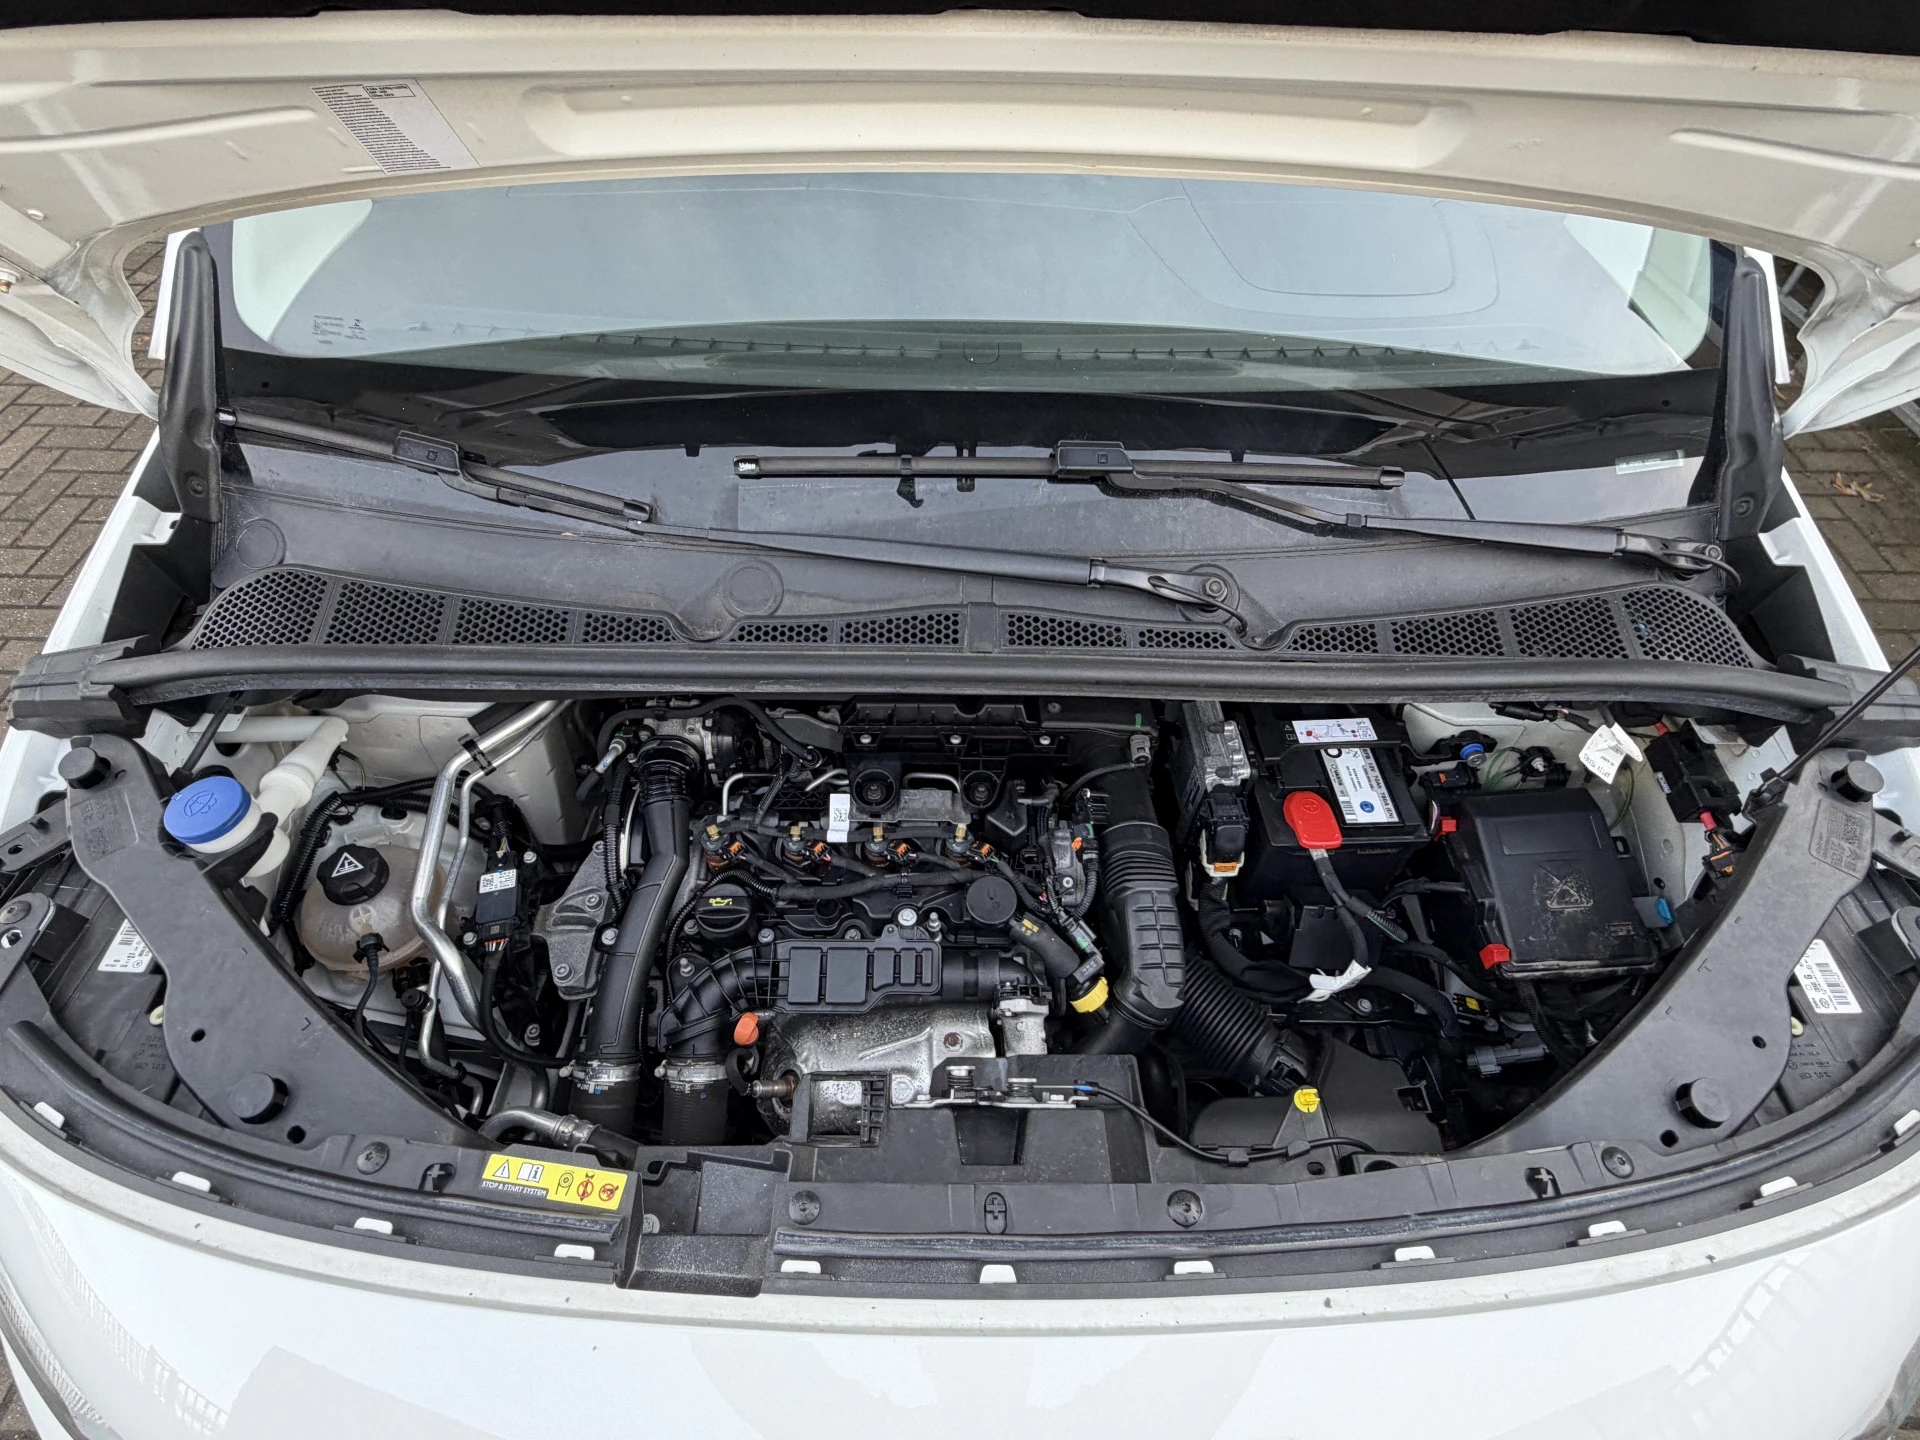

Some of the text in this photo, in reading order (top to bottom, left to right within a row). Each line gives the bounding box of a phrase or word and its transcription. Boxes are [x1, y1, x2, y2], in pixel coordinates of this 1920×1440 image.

[482, 1181, 498, 1189] STOP
[504, 1184, 522, 1193] START
[523, 1187, 547, 1196] SYSTEM
